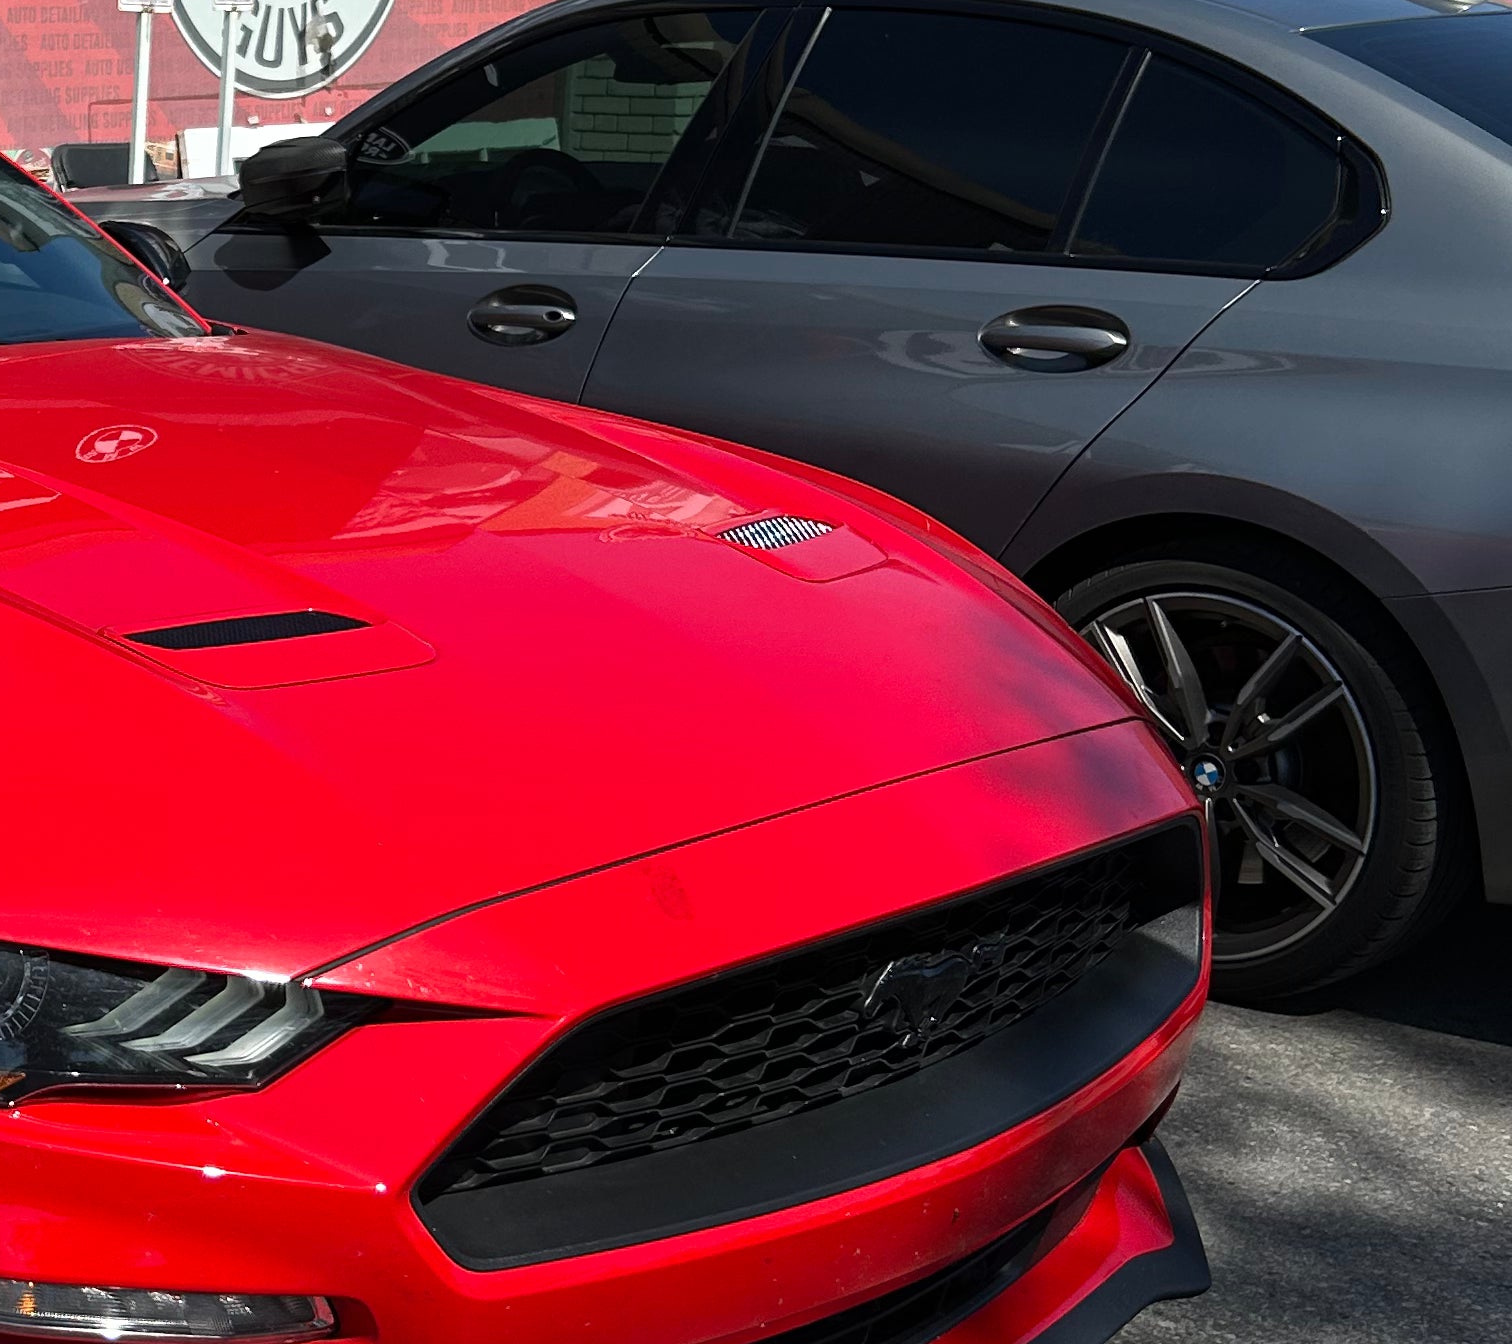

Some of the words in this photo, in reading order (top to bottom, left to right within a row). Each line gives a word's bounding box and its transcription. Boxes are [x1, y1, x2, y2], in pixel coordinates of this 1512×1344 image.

[6, 6, 37, 25] AUTO
[40, 33, 69, 51] AUTO
[64, 85, 121, 105] SUPPLIES
